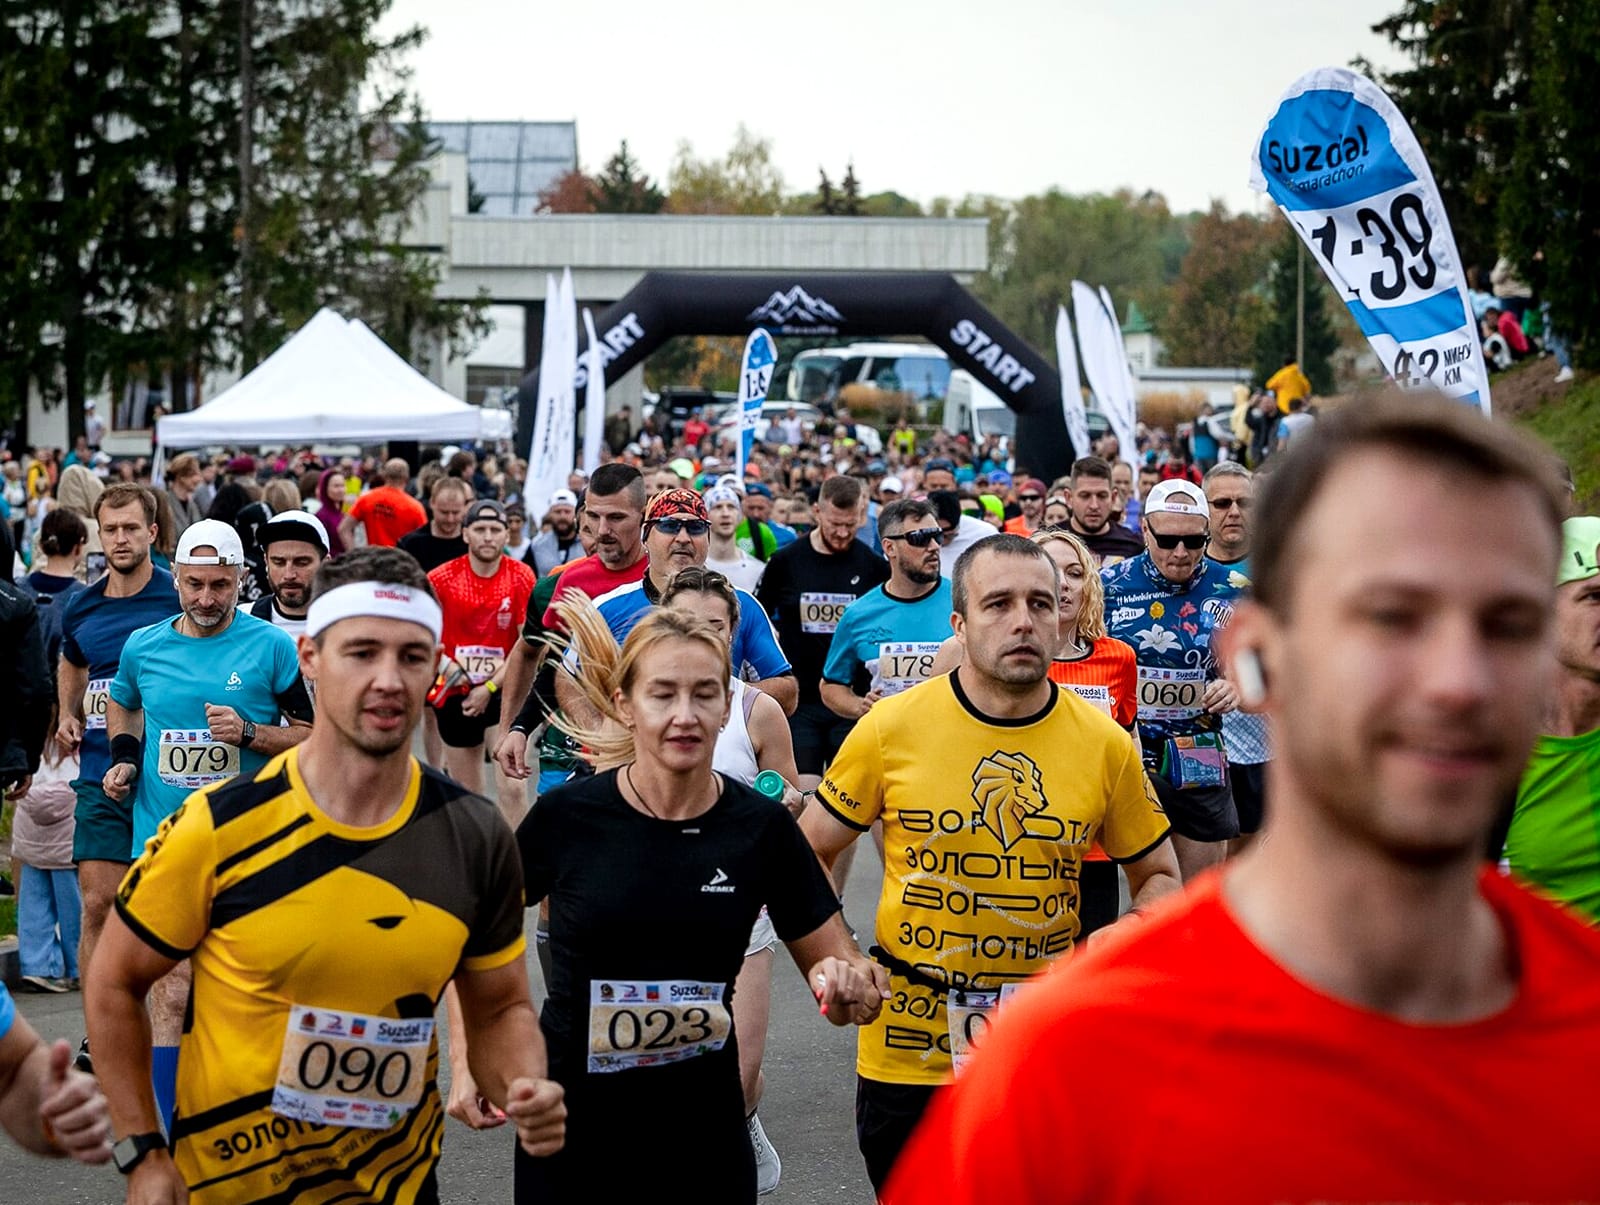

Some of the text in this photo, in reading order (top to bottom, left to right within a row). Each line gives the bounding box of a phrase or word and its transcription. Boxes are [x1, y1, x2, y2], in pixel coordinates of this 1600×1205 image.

[1268, 125, 1369, 174] Suzdal
[950, 319, 1036, 393] START
[464, 657, 496, 673] 175
[891, 655, 934, 678] 178
[90, 693, 107, 715] 16
[1074, 687, 1101, 696] Suzdal
[1141, 682, 1196, 706] 060
[169, 746, 229, 773] 079
[839, 791, 861, 809] бег
[904, 846, 1080, 881] ЗОЛОТЫЕ
[902, 882, 1078, 918] ВОРОТА
[898, 921, 1074, 961] ЗОЛОТЫЕ
[608, 1007, 713, 1051] 023
[298, 1041, 411, 1098] 090
